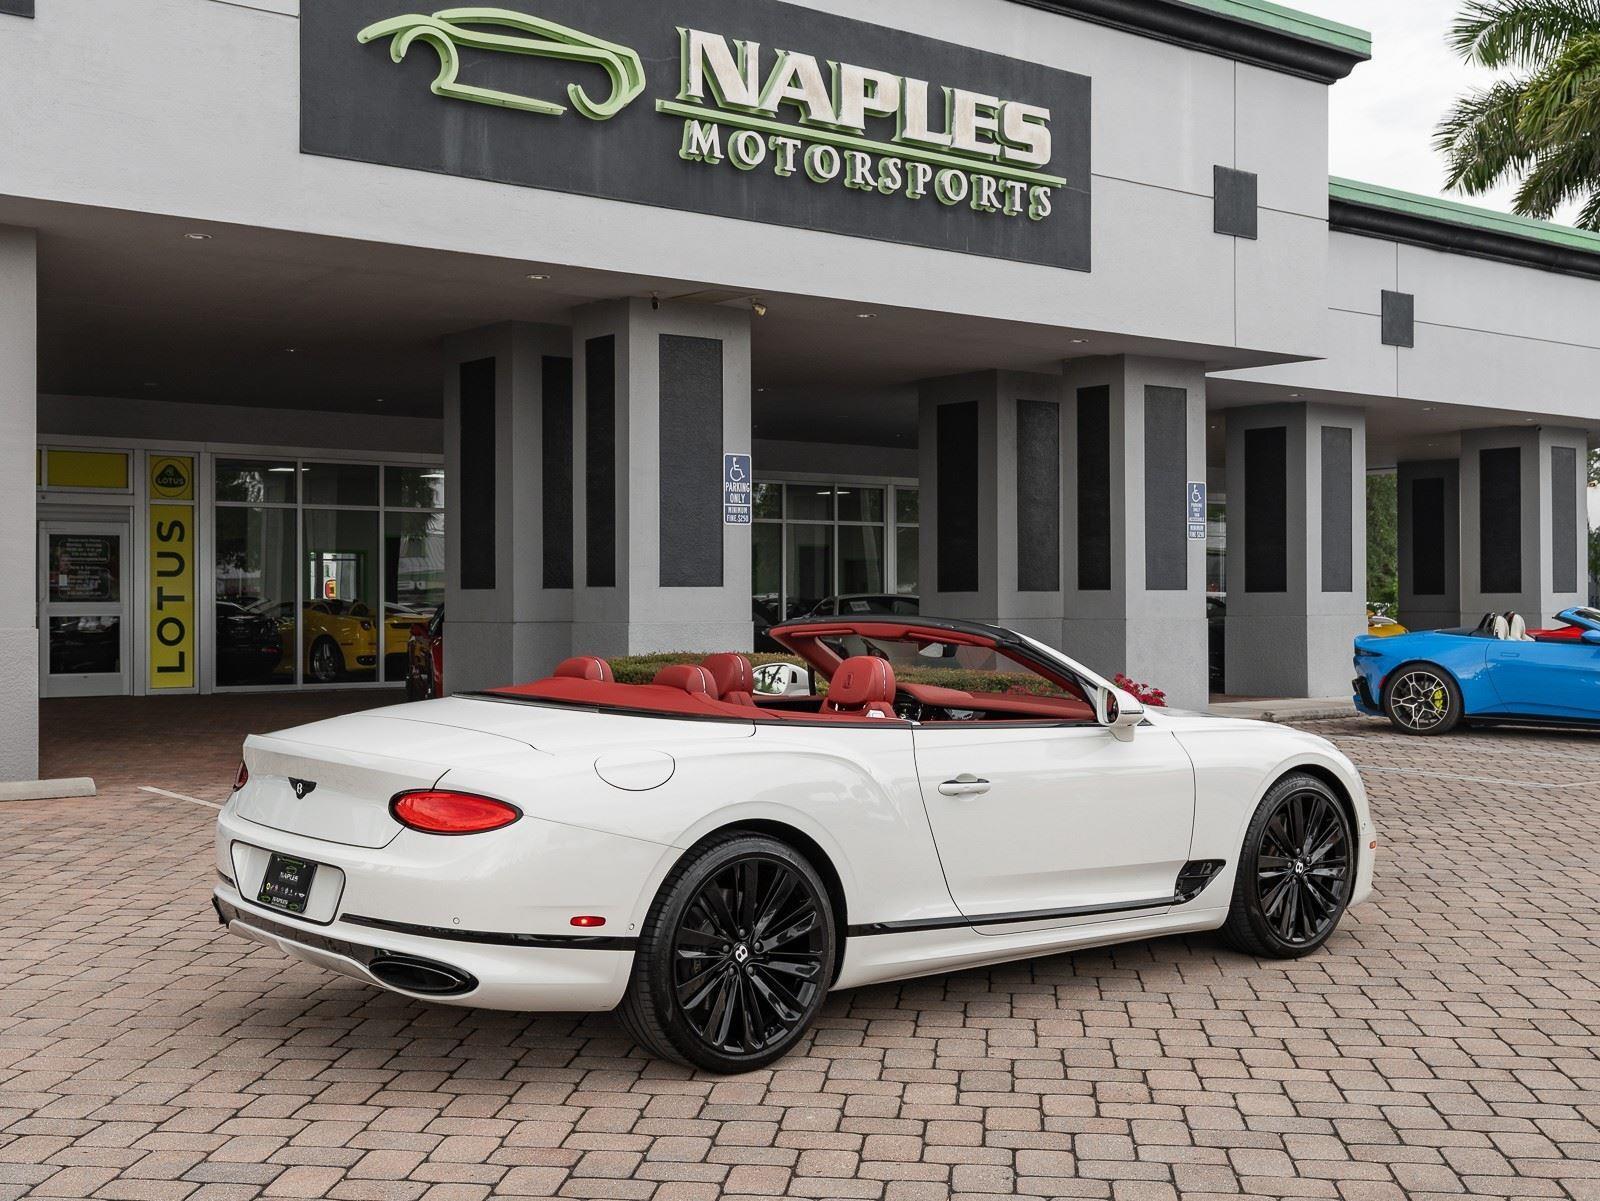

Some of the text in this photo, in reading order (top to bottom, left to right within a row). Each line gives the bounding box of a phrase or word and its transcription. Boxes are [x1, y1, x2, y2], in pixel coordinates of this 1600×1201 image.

[676, 27, 1052, 168] NAPLES
[679, 119, 1052, 221] MOTORSPORTS
[157, 477, 184, 485] LOTUS
[726, 482, 750, 492] PARKING
[729, 493, 746, 503] ONLY
[157, 519, 185, 673] LOTUS
